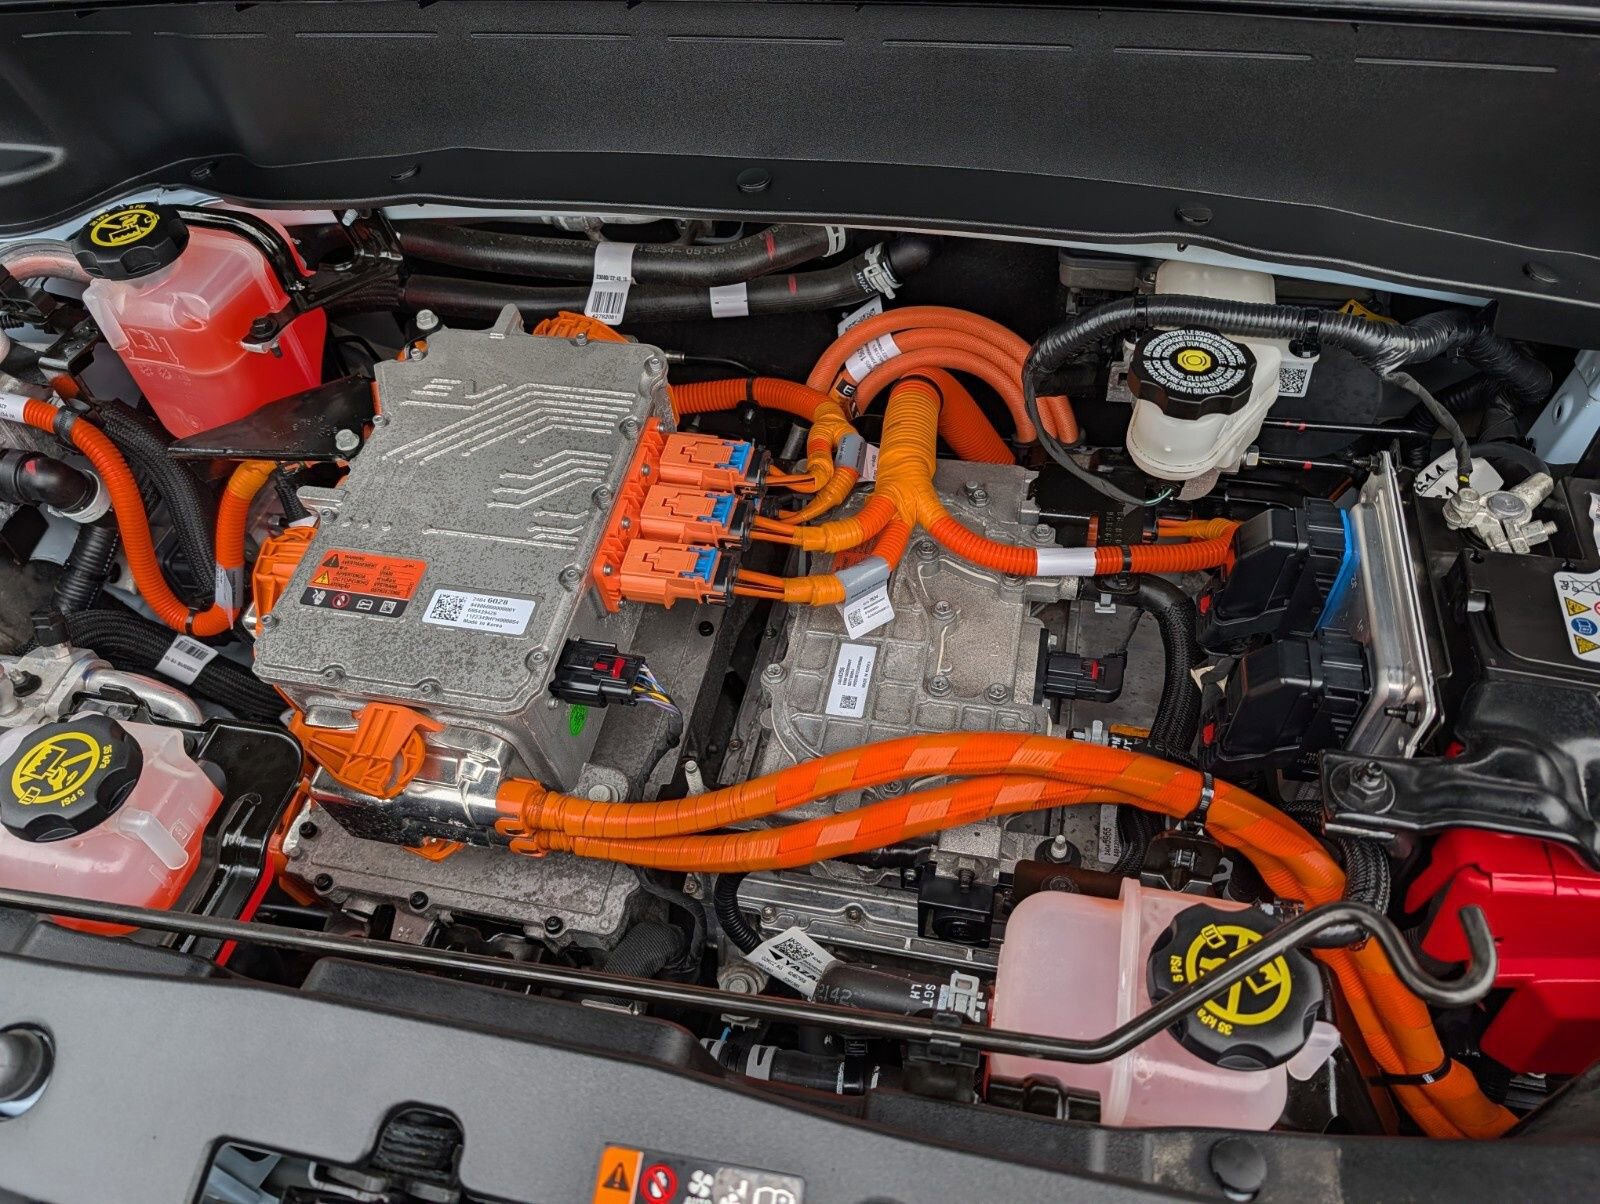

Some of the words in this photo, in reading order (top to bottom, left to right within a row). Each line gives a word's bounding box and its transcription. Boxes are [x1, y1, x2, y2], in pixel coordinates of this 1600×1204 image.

[856, 272, 873, 294] HVAC
[102, 744, 112, 754] 35
[99, 754, 112, 769] kPa
[61, 794, 78, 808] PSI
[786, 960, 818, 982] YAZA
[1170, 955, 1182, 973] PSI
[1172, 974, 1185, 983] 5
[908, 984, 922, 1000] LH
[922, 983, 937, 1008] SGT
[1196, 1008, 1218, 1029] kPa
[1217, 1022, 1234, 1036] 35
